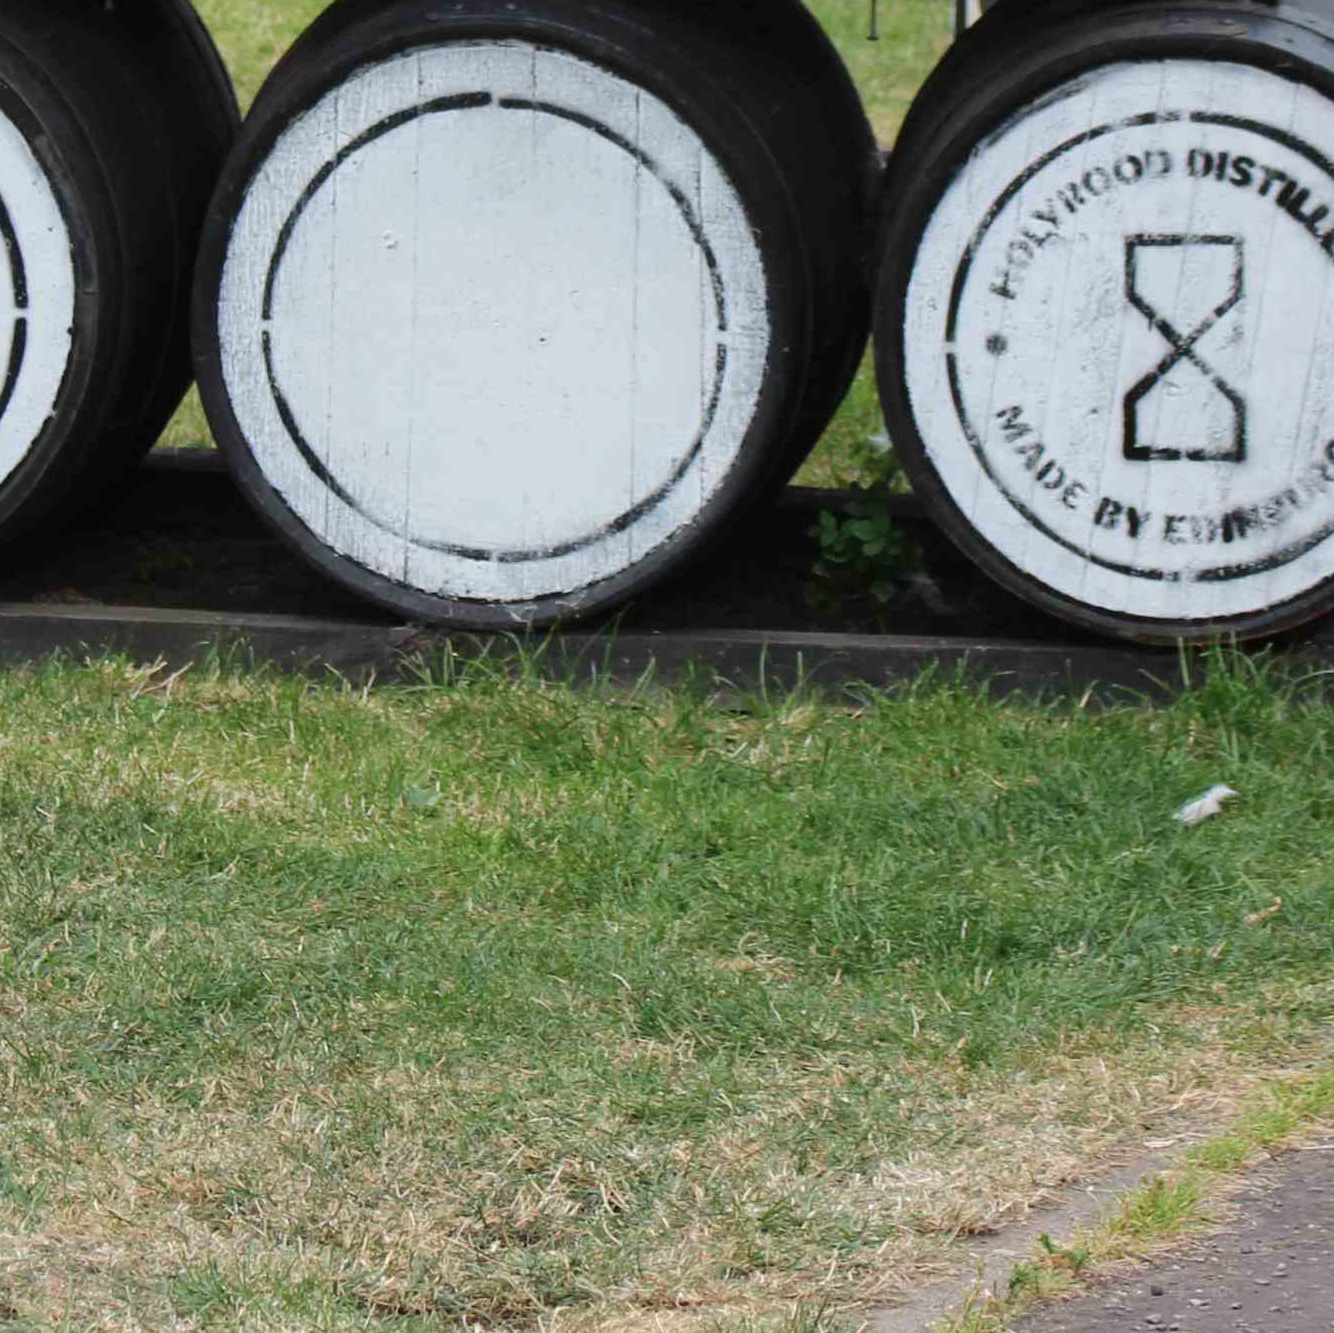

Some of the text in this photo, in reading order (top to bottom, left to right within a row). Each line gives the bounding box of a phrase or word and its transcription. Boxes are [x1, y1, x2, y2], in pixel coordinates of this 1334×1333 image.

[988, 150, 1172, 301] HOLYROOD
[996, 404, 1087, 511] MADE
[1094, 498, 1148, 538] BY
